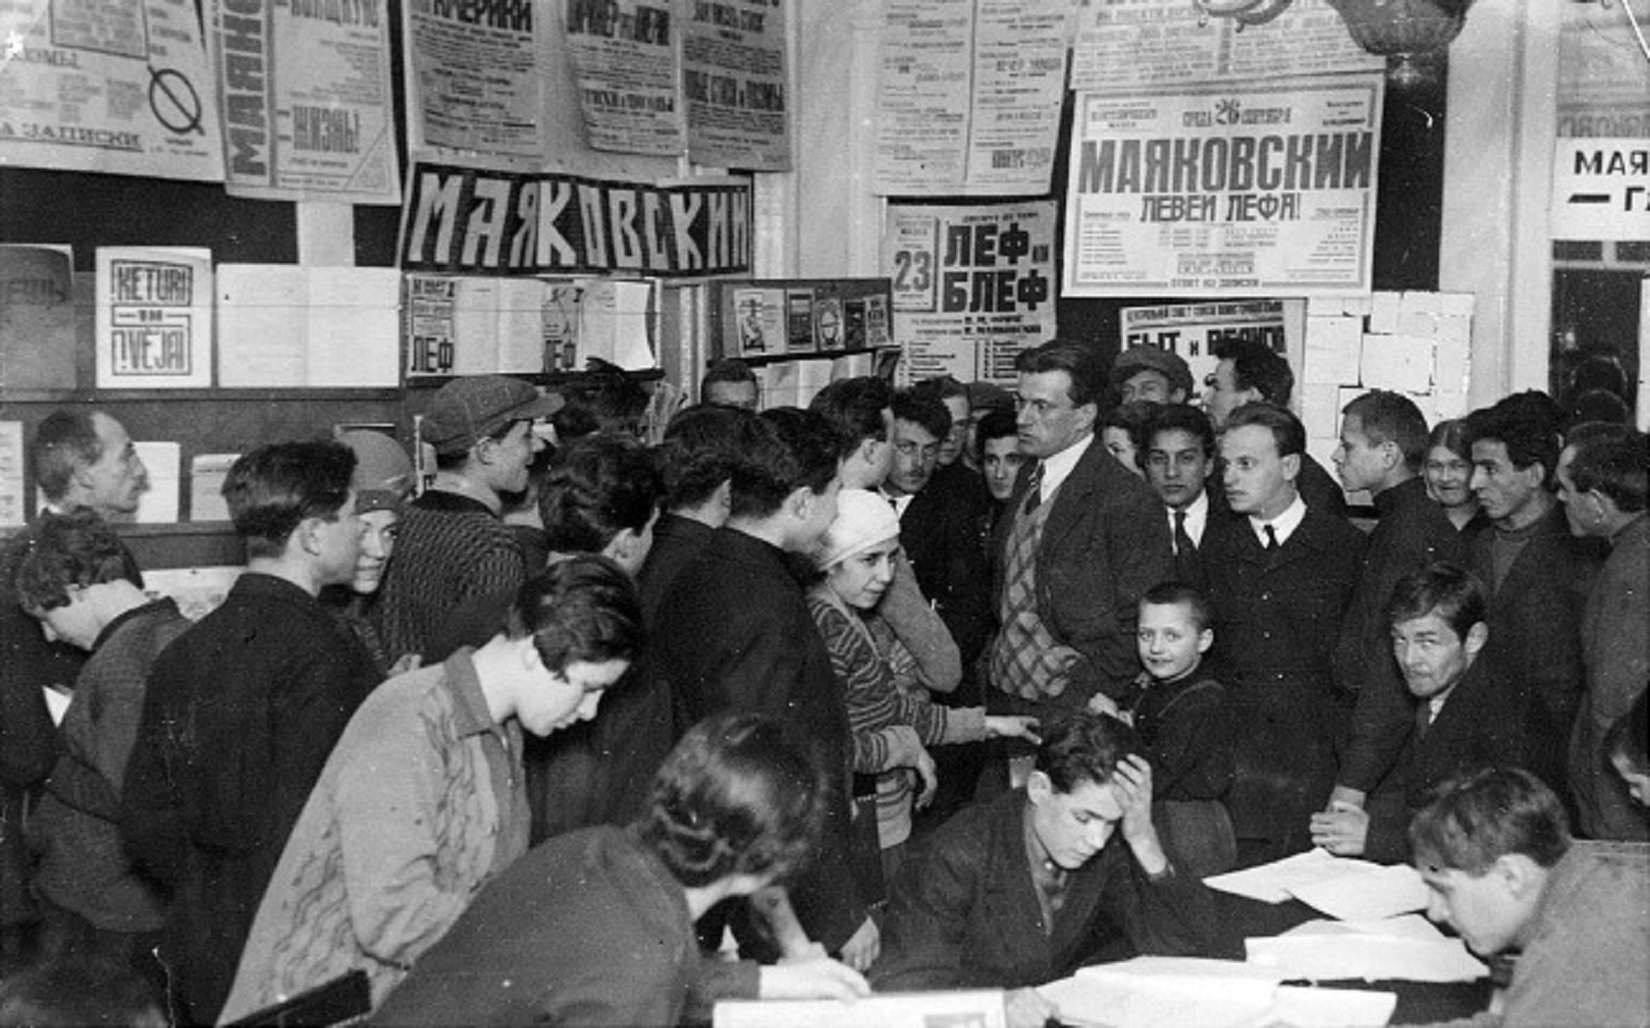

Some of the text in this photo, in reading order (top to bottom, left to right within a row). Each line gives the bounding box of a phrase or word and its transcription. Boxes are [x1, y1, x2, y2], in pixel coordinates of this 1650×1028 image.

[1215, 98, 1242, 126] 26
[1078, 127, 1373, 194] МАЯКОВСКИЙ
[1575, 150, 1648, 175] МАЯ
[1224, 192, 1302, 222] ЛЕФА!
[1624, 186, 1650, 211] Г
[943, 223, 1030, 266] ЛЕФ
[894, 250, 933, 292] 23
[942, 269, 1049, 312] БЛЕФ
[411, 336, 455, 373] ЛЕФ
